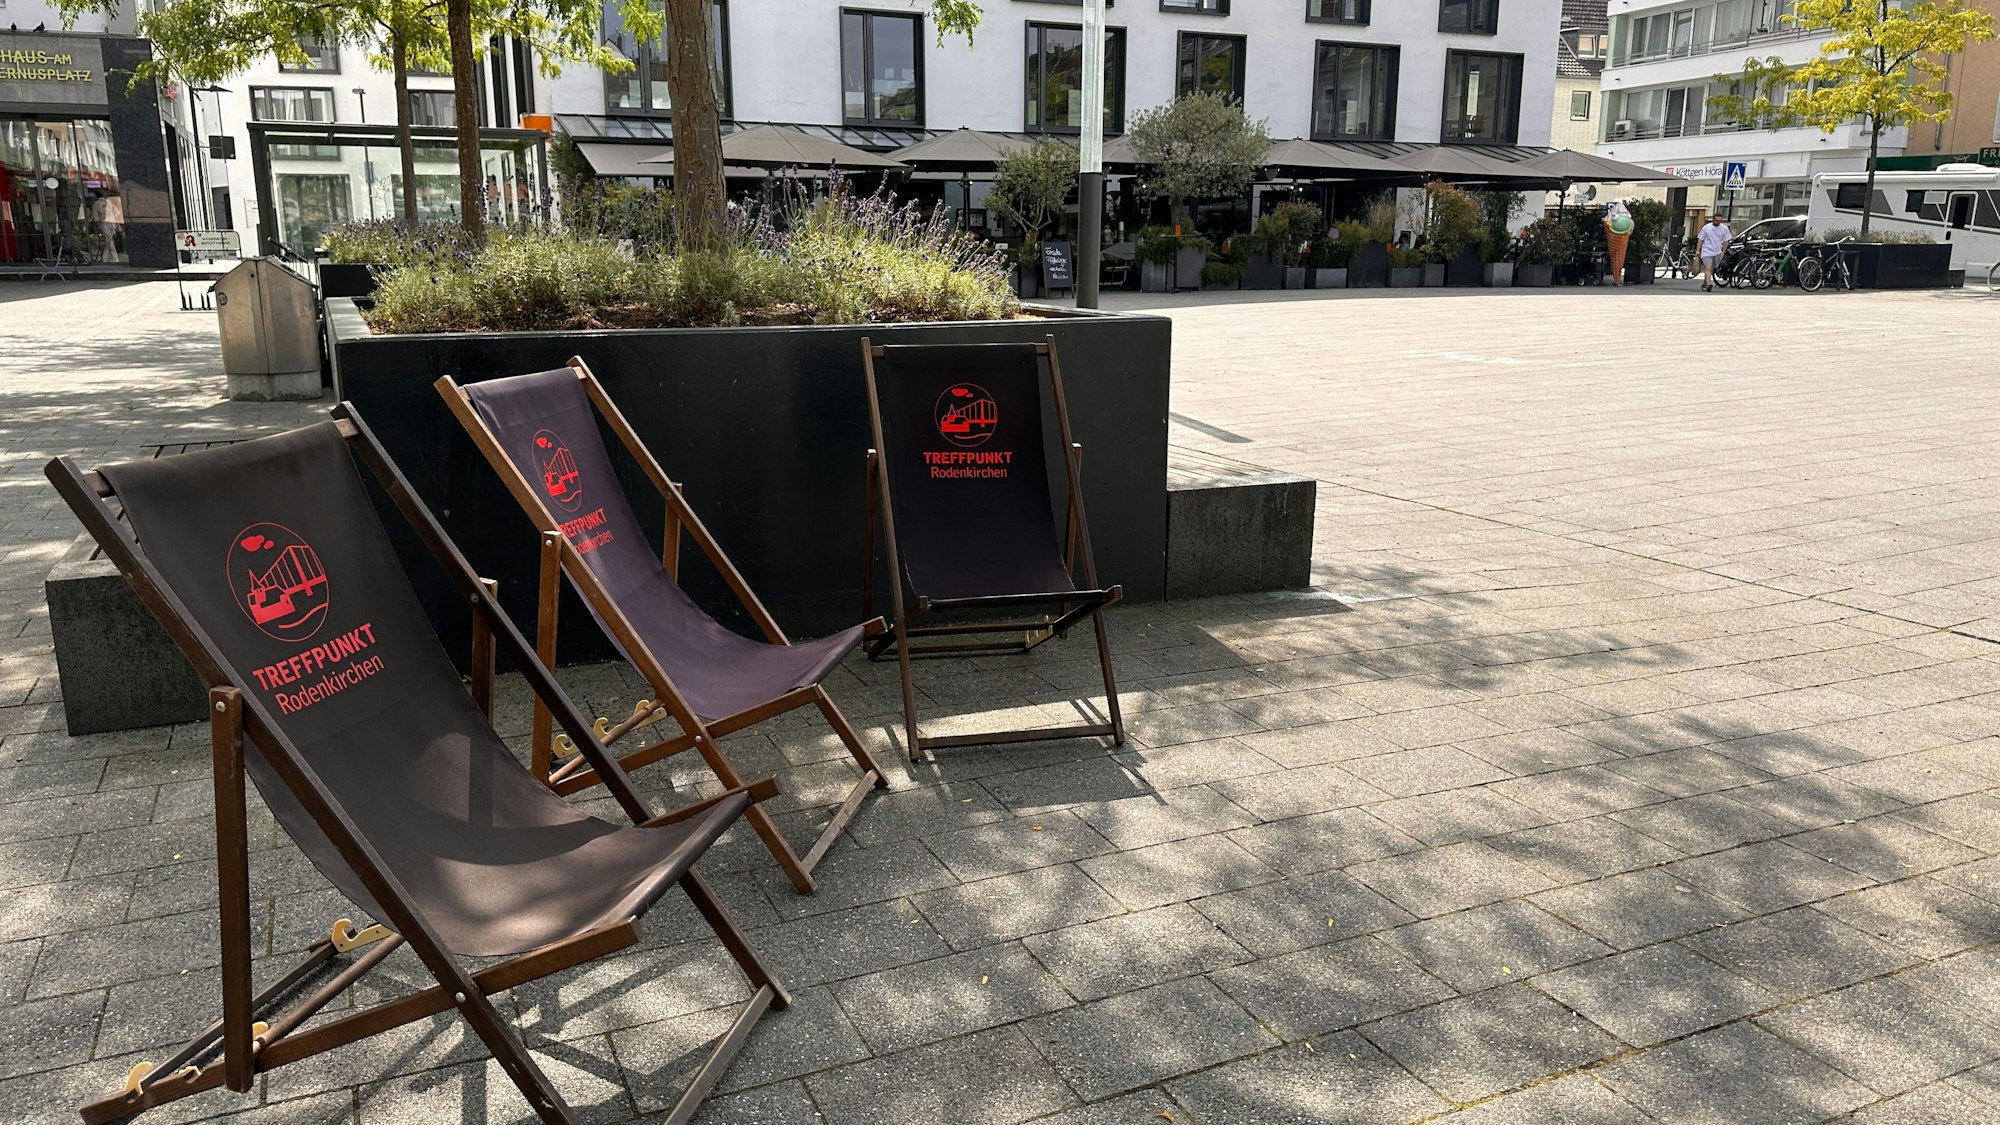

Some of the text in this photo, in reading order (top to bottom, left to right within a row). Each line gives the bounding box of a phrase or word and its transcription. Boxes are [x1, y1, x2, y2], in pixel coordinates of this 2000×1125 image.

[54, 54, 72, 65] AM
[1676, 167, 1703, 179] Köttgen
[923, 452, 1012, 464] TREFFPUNKT
[931, 466, 1008, 478] Rodenkirchen
[560, 508, 607, 538] REFFPUNKT
[575, 530, 614, 554] odenkirchen
[252, 622, 377, 692] TREFFPUNKT
[274, 654, 385, 715] Rodenkirchen
